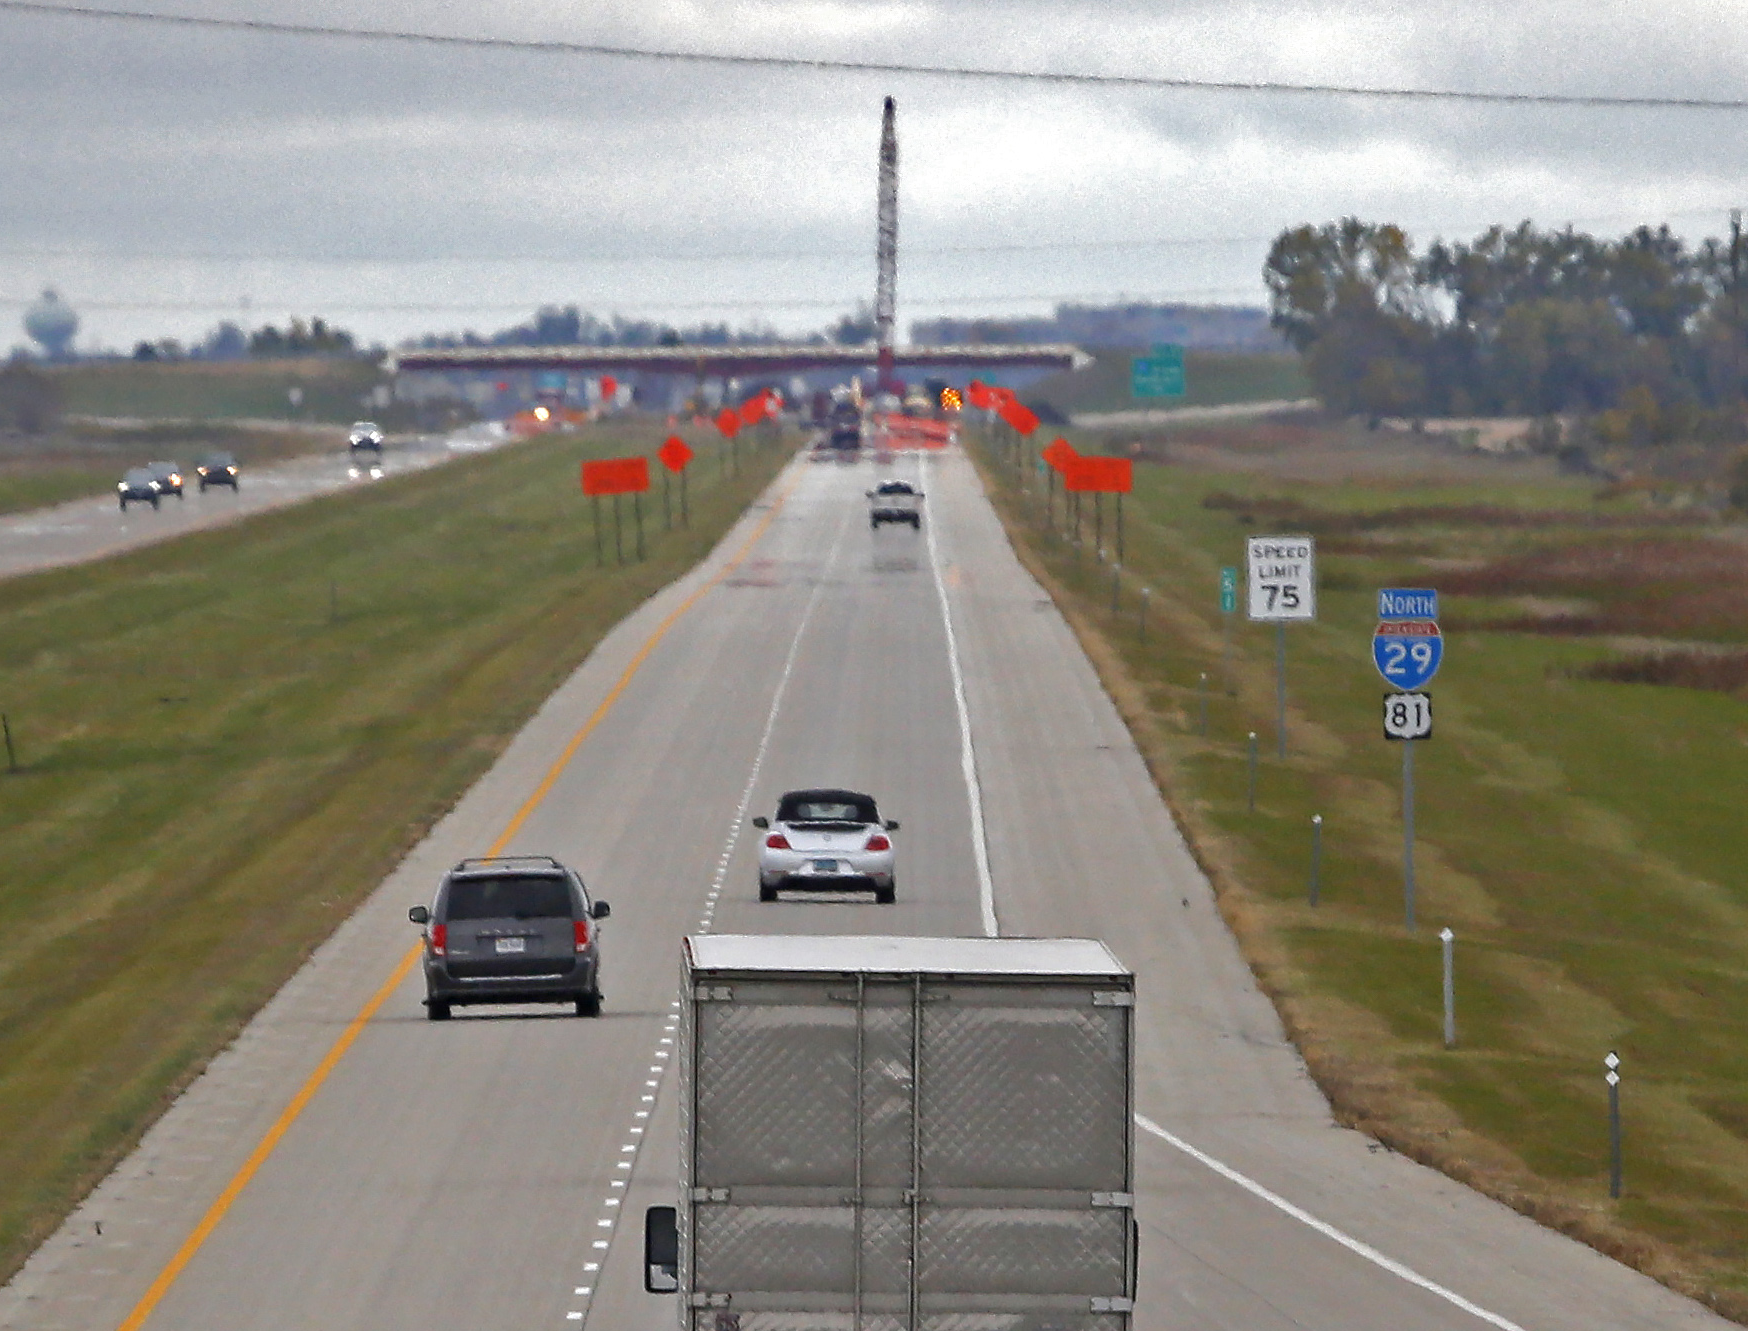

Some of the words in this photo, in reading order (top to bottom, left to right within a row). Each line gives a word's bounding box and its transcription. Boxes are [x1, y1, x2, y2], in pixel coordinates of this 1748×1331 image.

[1253, 545, 1308, 558] SPEED
[1258, 564, 1300, 578] LIMIT
[1261, 585, 1300, 611] 75
[1380, 592, 1434, 615] NORTH
[1384, 642, 1432, 674] 29
[1392, 703, 1421, 728] 81
